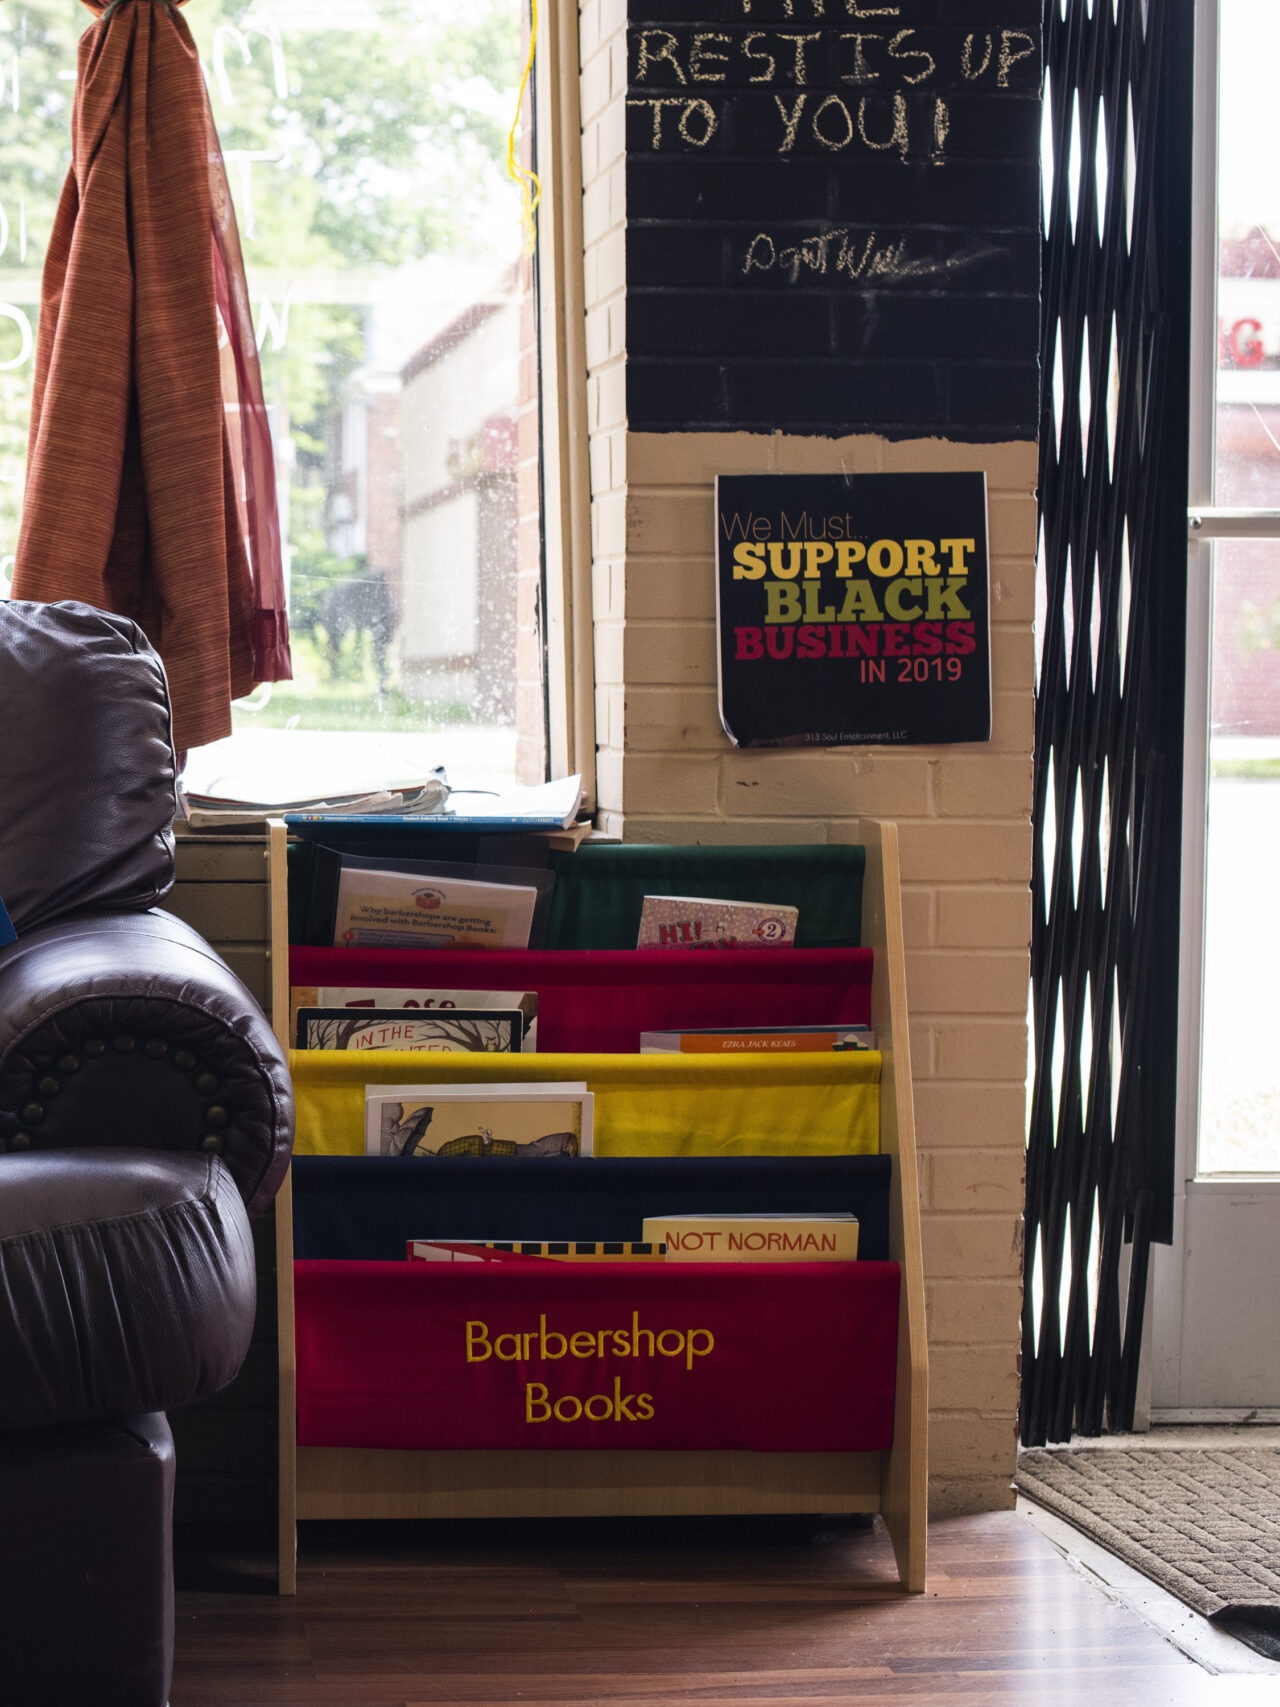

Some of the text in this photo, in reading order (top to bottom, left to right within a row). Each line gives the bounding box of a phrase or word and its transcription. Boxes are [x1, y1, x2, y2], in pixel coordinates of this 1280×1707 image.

[635, 29, 1035, 87] REST IS UP
[627, 97, 718, 149] TO
[720, 511, 771, 540] We
[732, 538, 975, 580] SUPPORT
[763, 577, 971, 623] BLACK
[734, 621, 976, 660] BUSINESS
[860, 658, 962, 683] IN 2019
[765, 923, 777, 938] 2
[356, 1025, 415, 1049] IN THE
[746, 1040, 768, 1048] JACK
[665, 1232, 836, 1251] NOT NORMAN
[465, 1310, 715, 1370] Barbershop
[525, 1376, 655, 1423] Books
